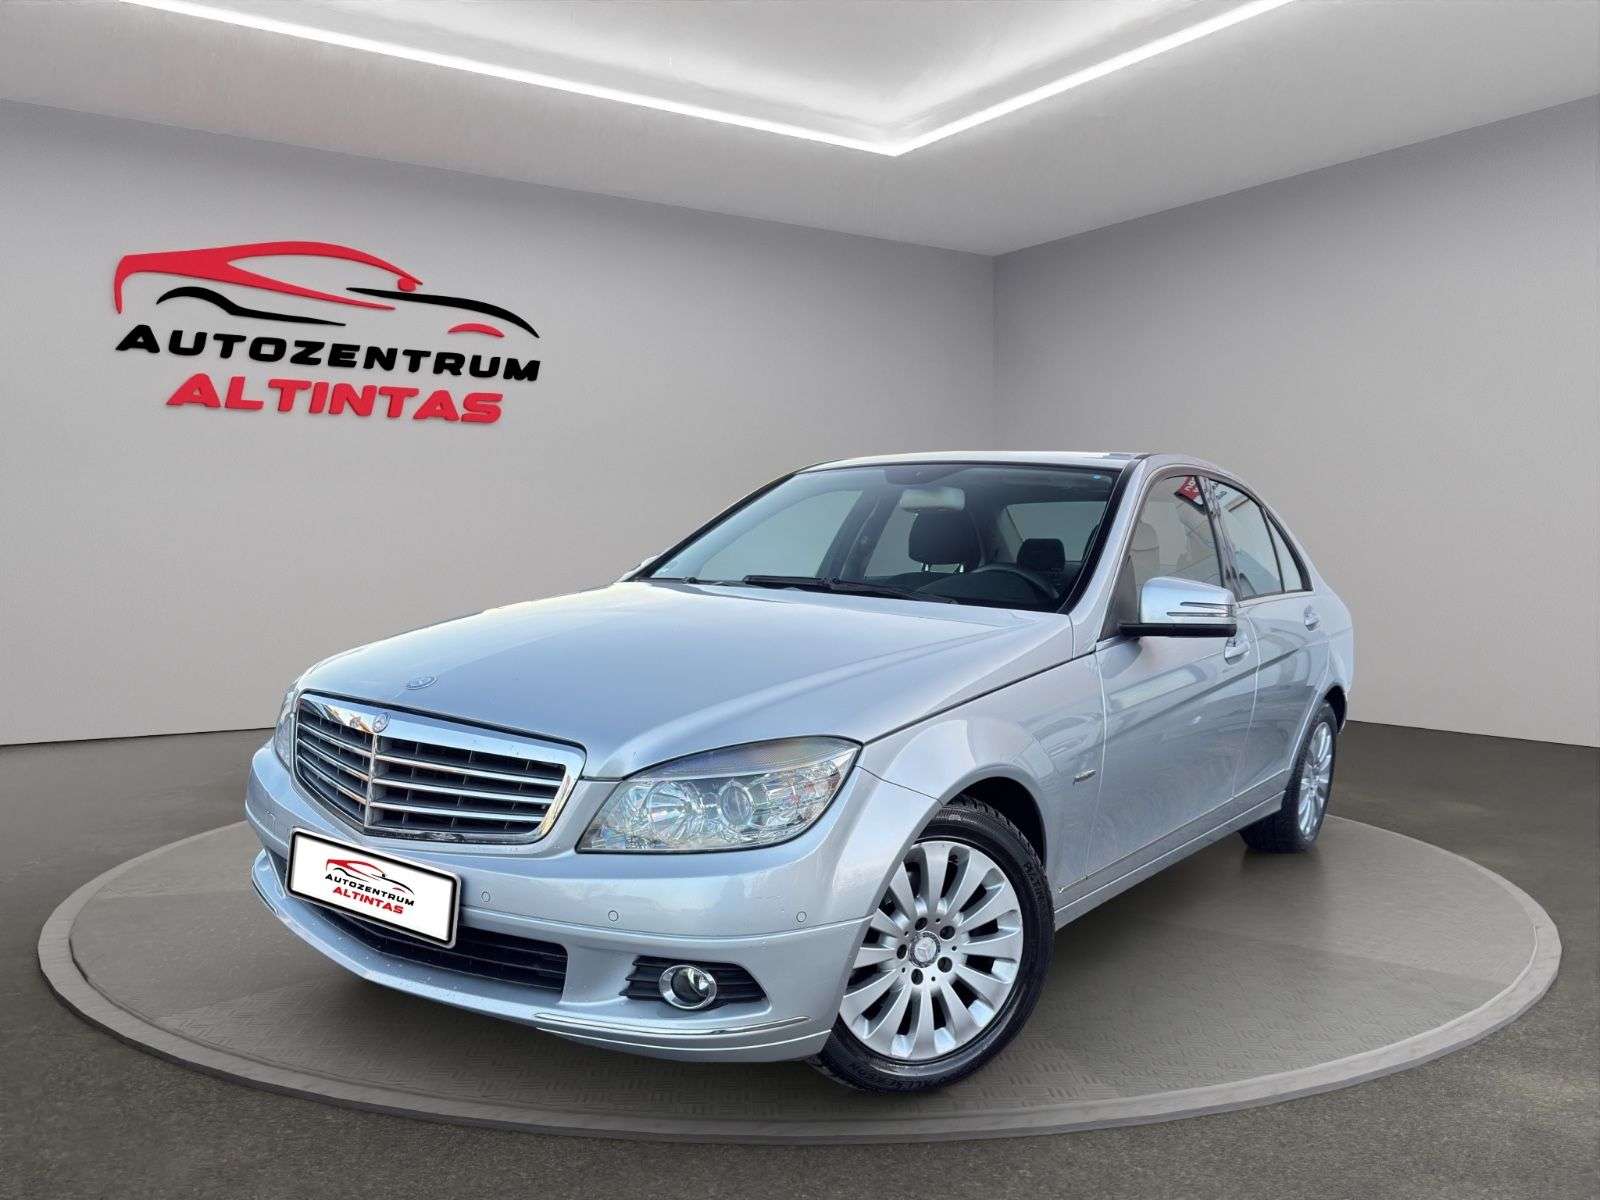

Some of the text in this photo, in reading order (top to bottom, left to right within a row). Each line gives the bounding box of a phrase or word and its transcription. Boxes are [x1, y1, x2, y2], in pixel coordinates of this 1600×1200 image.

[115, 324, 540, 381] AUTOZENTRUM
[166, 373, 504, 423] ALTINTAS
[325, 873, 415, 906] AUTOZENTRUM
[333, 886, 404, 914] ALTINTAS
